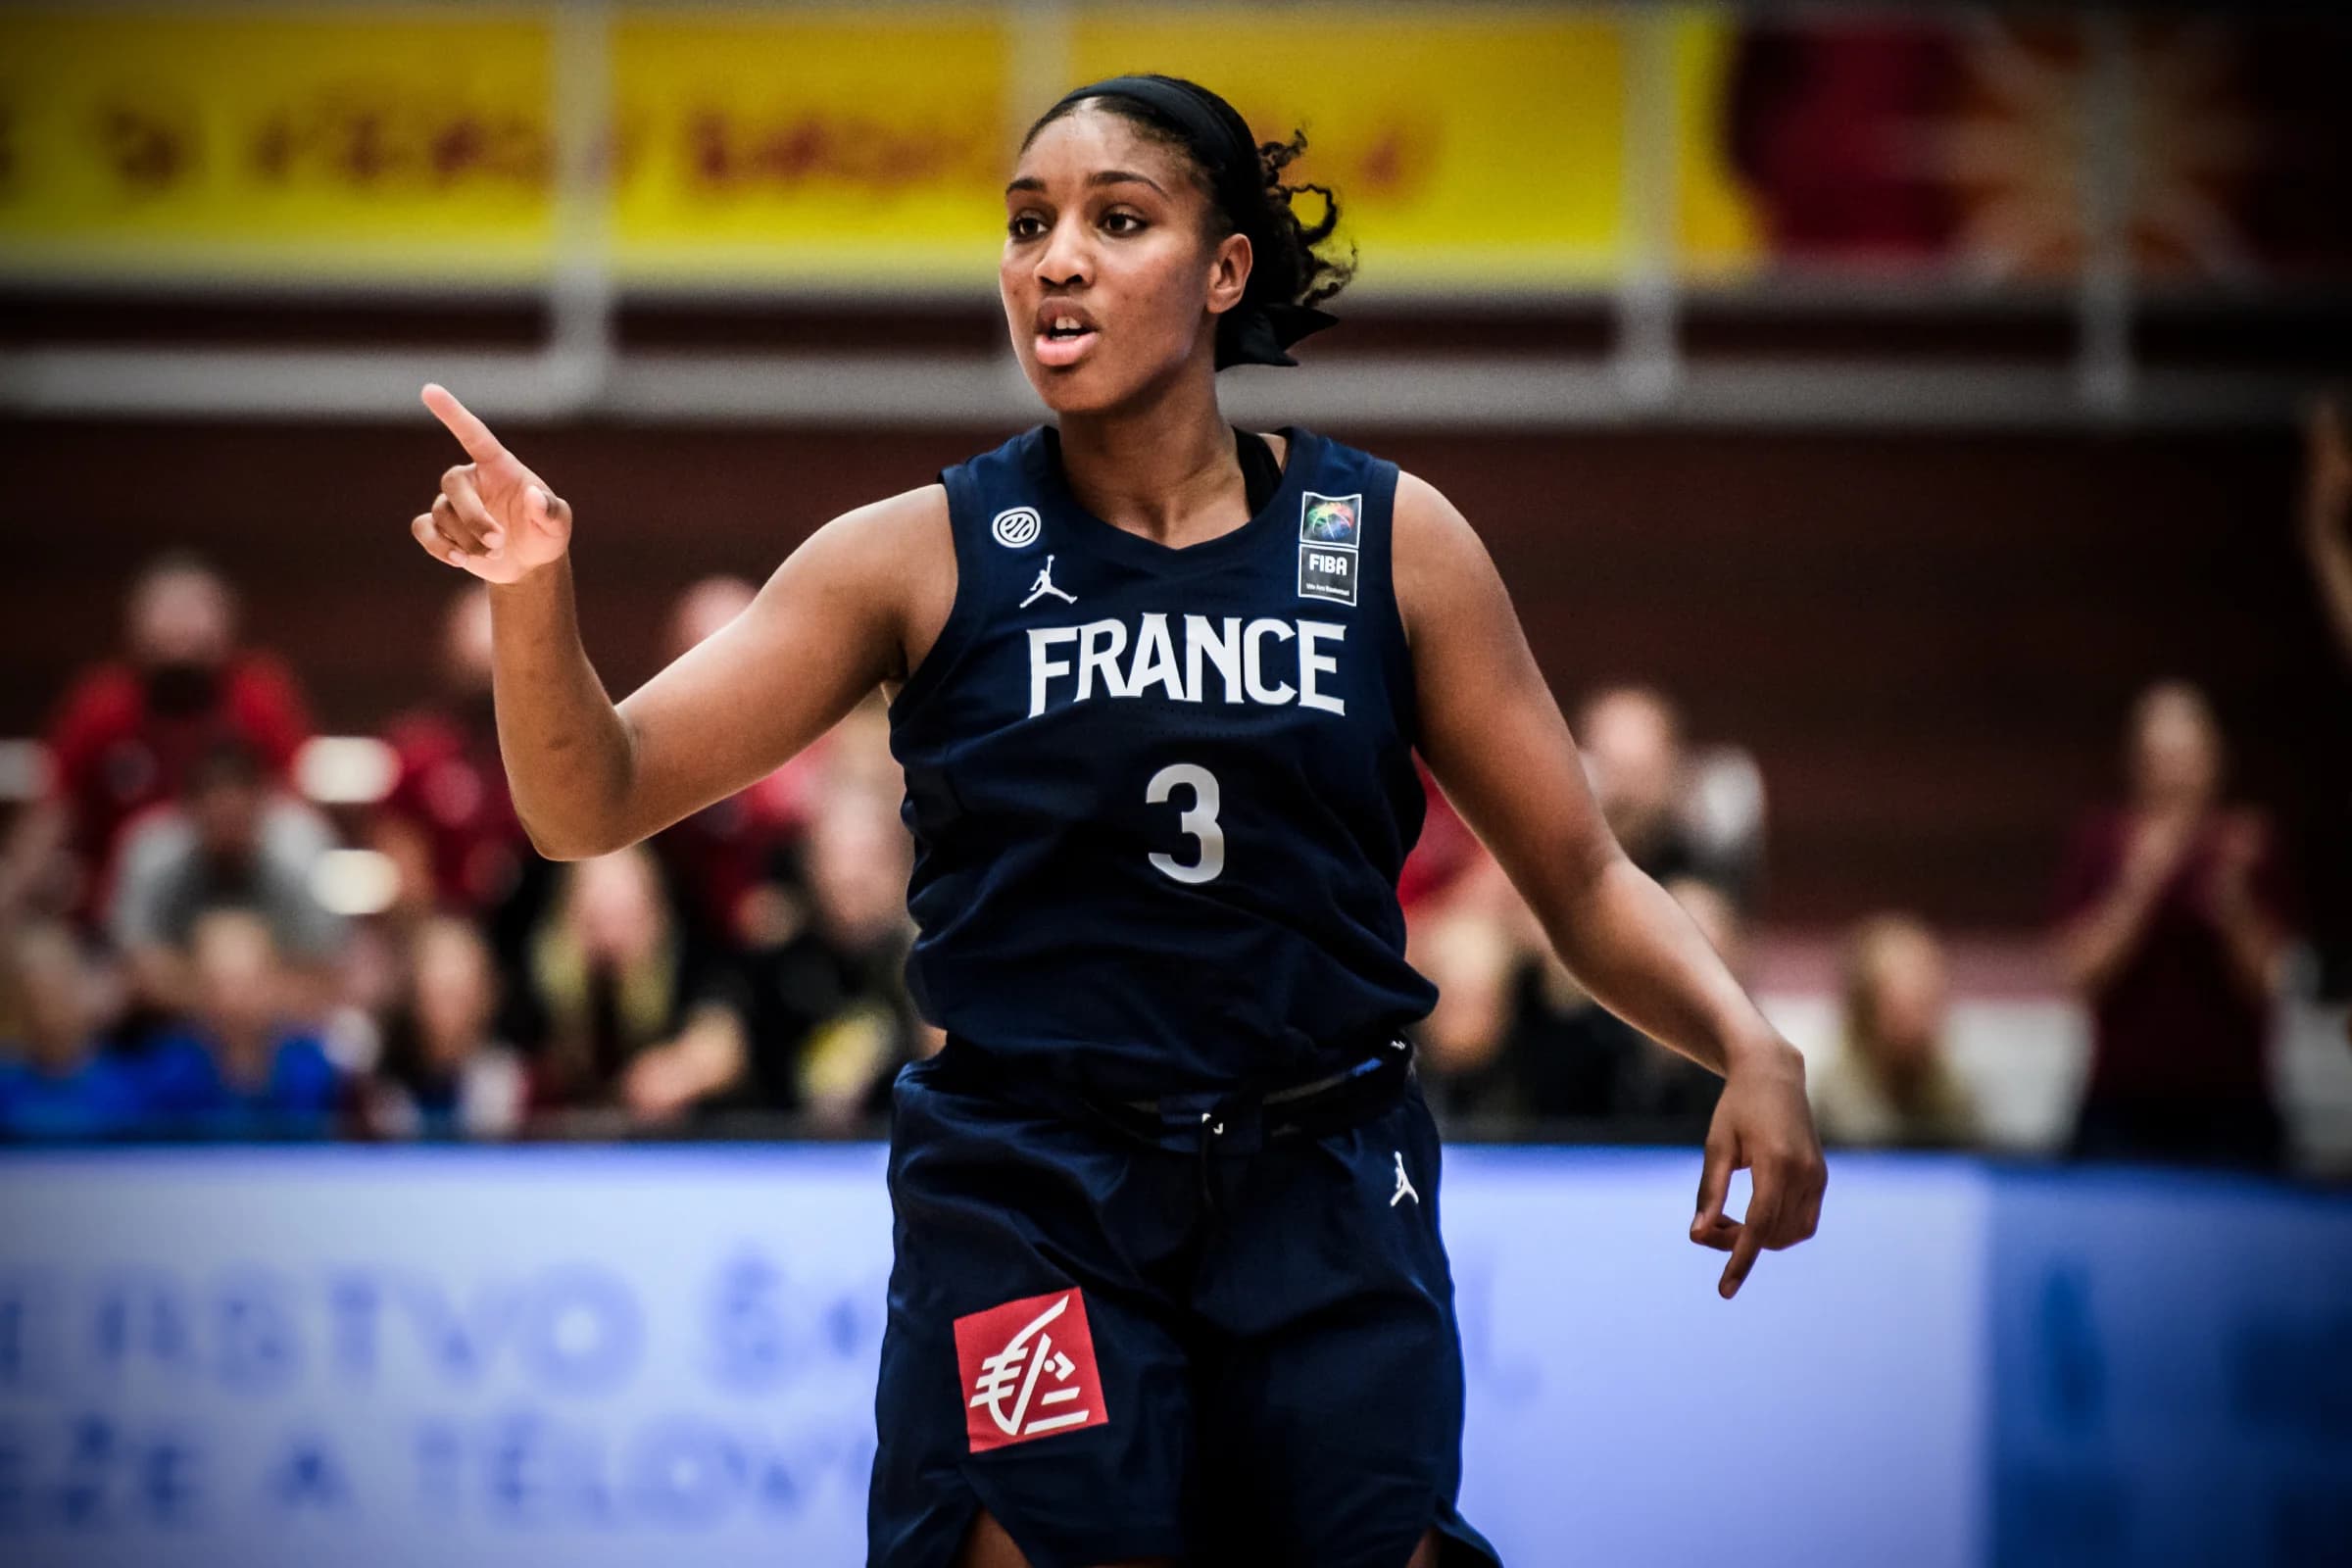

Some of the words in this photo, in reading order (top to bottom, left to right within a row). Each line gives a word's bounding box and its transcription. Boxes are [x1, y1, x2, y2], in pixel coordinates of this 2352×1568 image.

[1309, 553, 1348, 576] FIBA
[1027, 612, 1347, 718] FRANCE
[1146, 762, 1225, 883] 3
